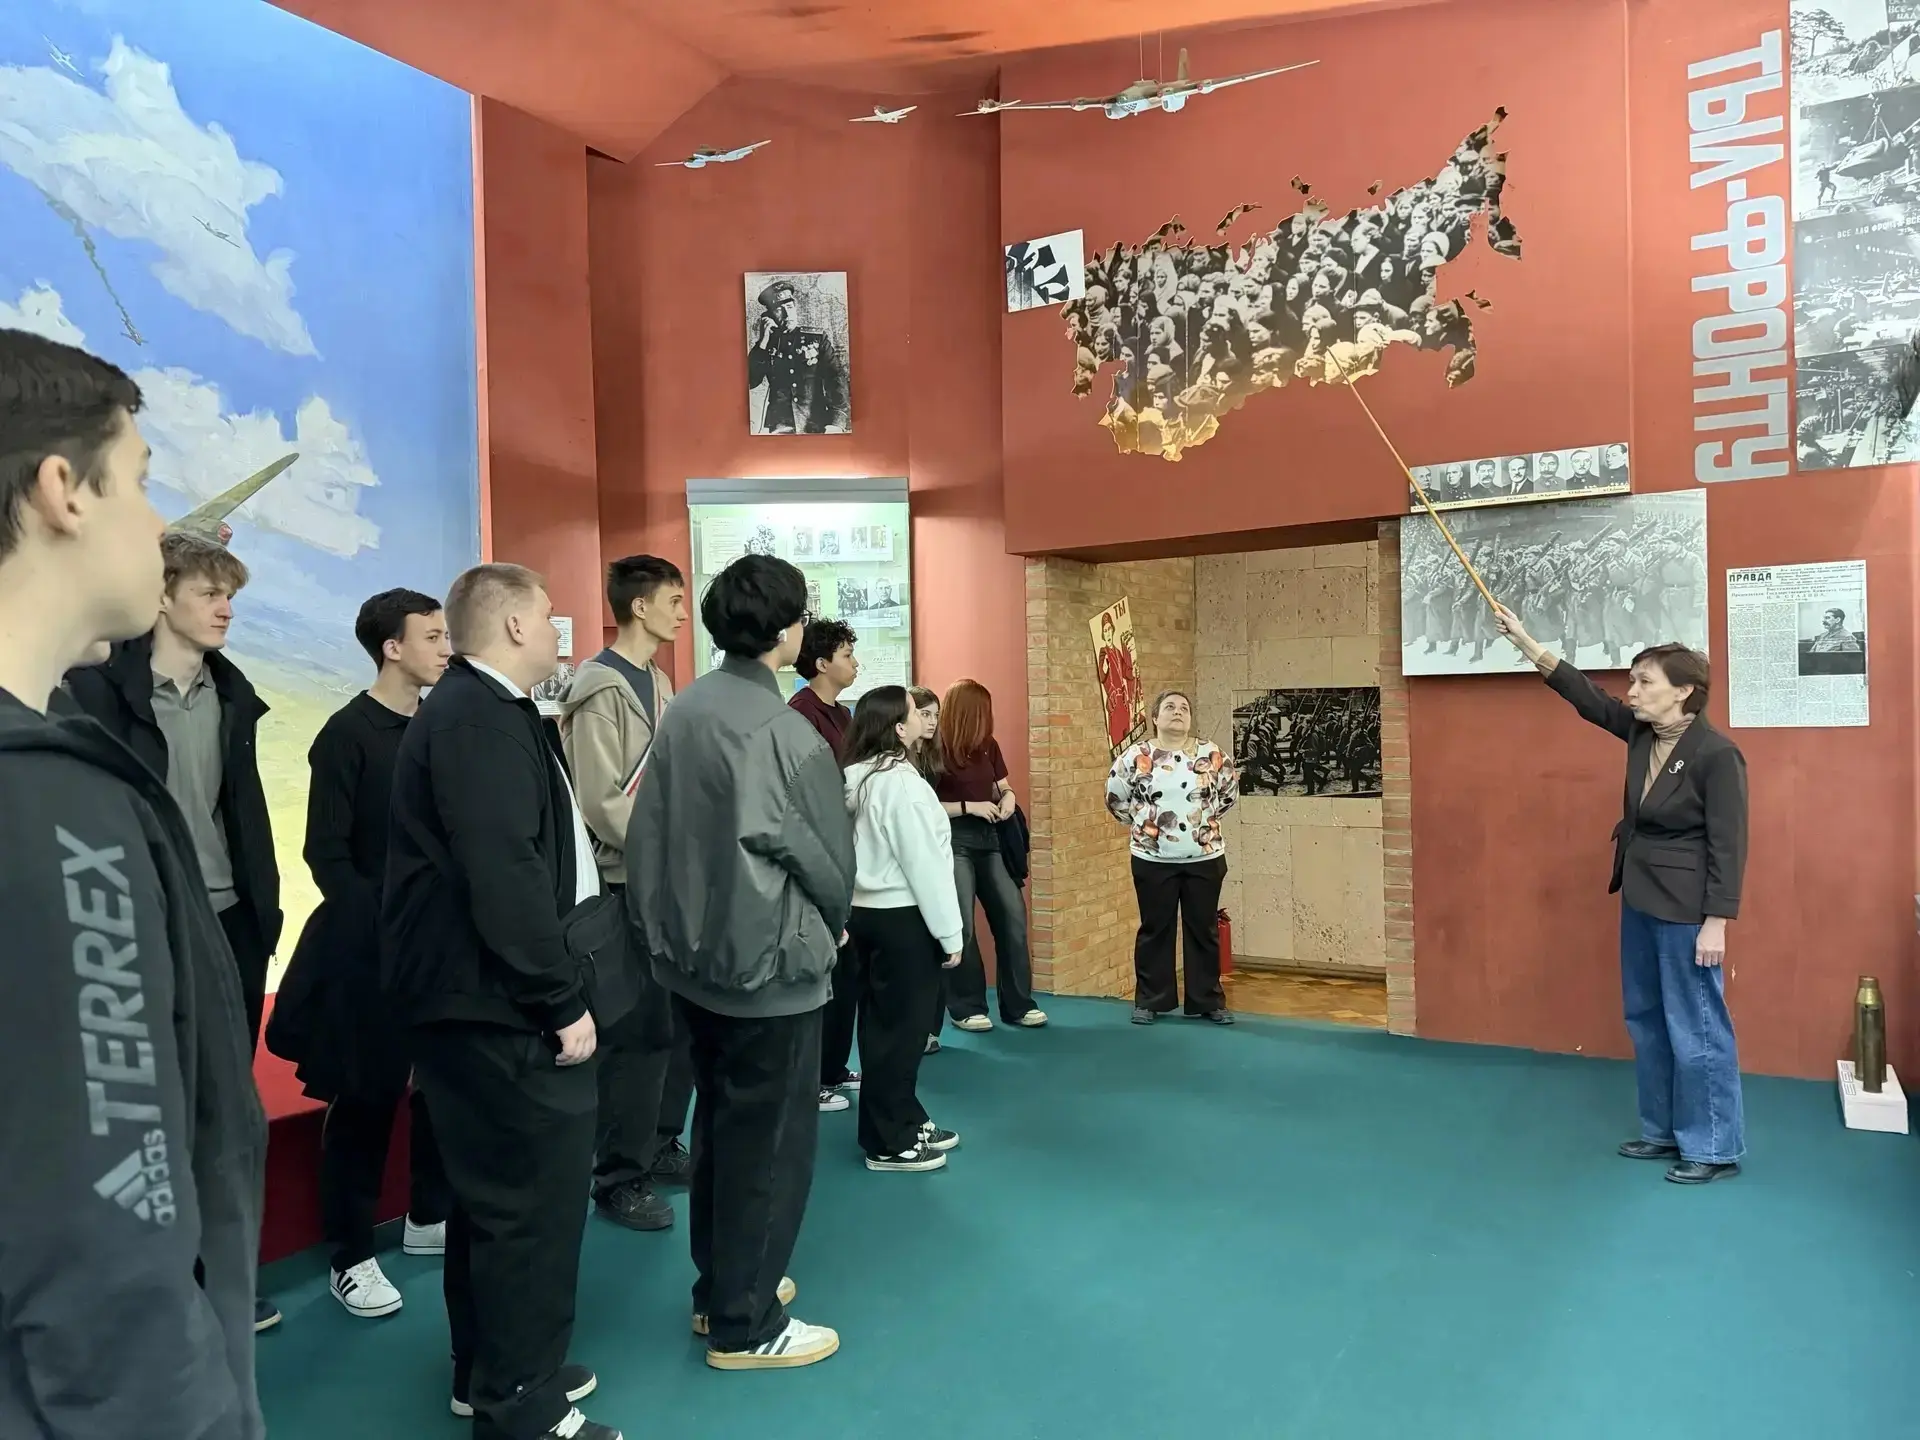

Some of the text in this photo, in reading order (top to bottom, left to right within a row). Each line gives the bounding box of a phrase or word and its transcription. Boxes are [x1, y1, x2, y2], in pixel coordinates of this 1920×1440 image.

[1687, 28, 1790, 484] ТЫЛ-ФРОНТУ
[1113, 600, 1126, 620] ТЫ
[1729, 572, 1772, 583] ПРАВДА
[54, 824, 162, 1137] TERREX
[143, 1128, 177, 1227] adidas
